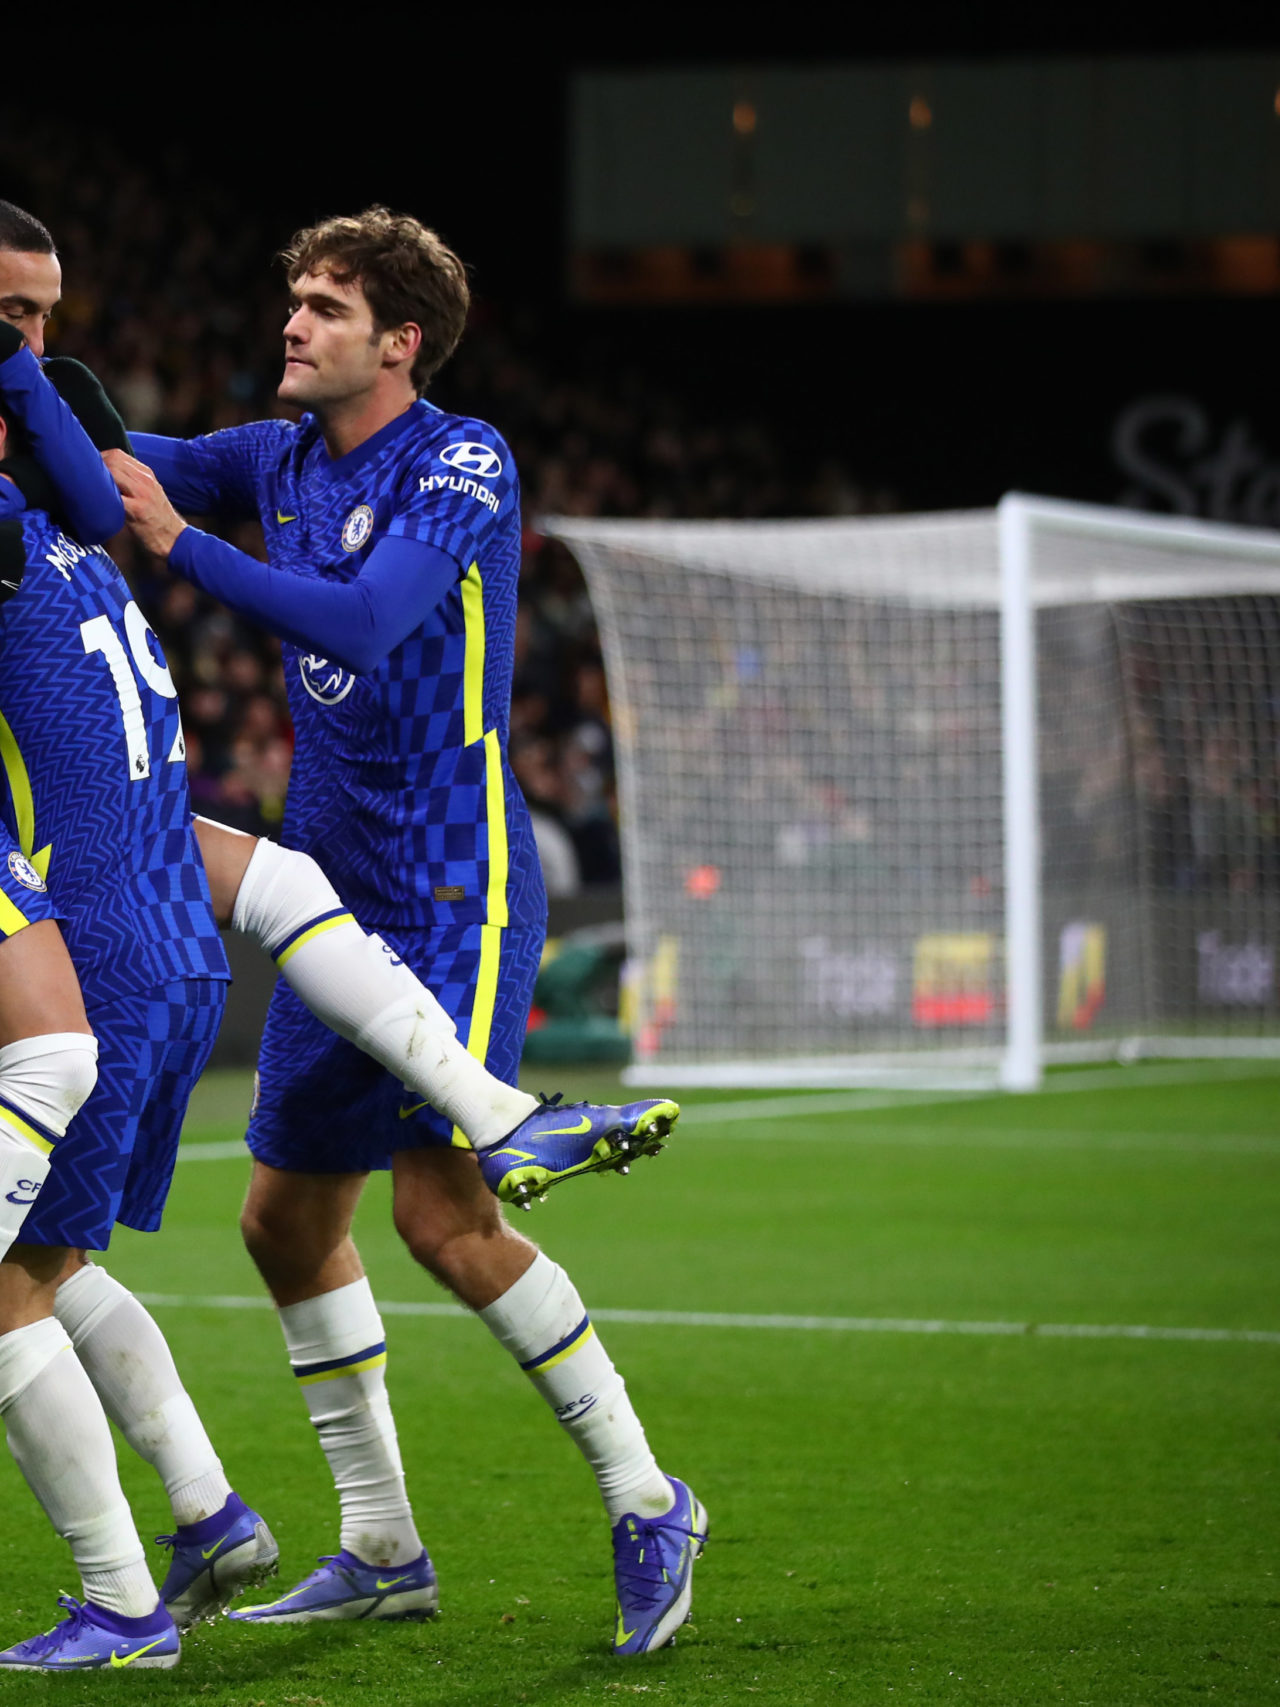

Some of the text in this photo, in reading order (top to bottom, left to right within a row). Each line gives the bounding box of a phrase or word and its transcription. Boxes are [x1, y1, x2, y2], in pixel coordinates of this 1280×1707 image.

[419, 475, 500, 514] HYUNDAI
[45, 532, 101, 582] MOU
[80, 600, 186, 781] 19
[17, 1179, 42, 1193] CF
